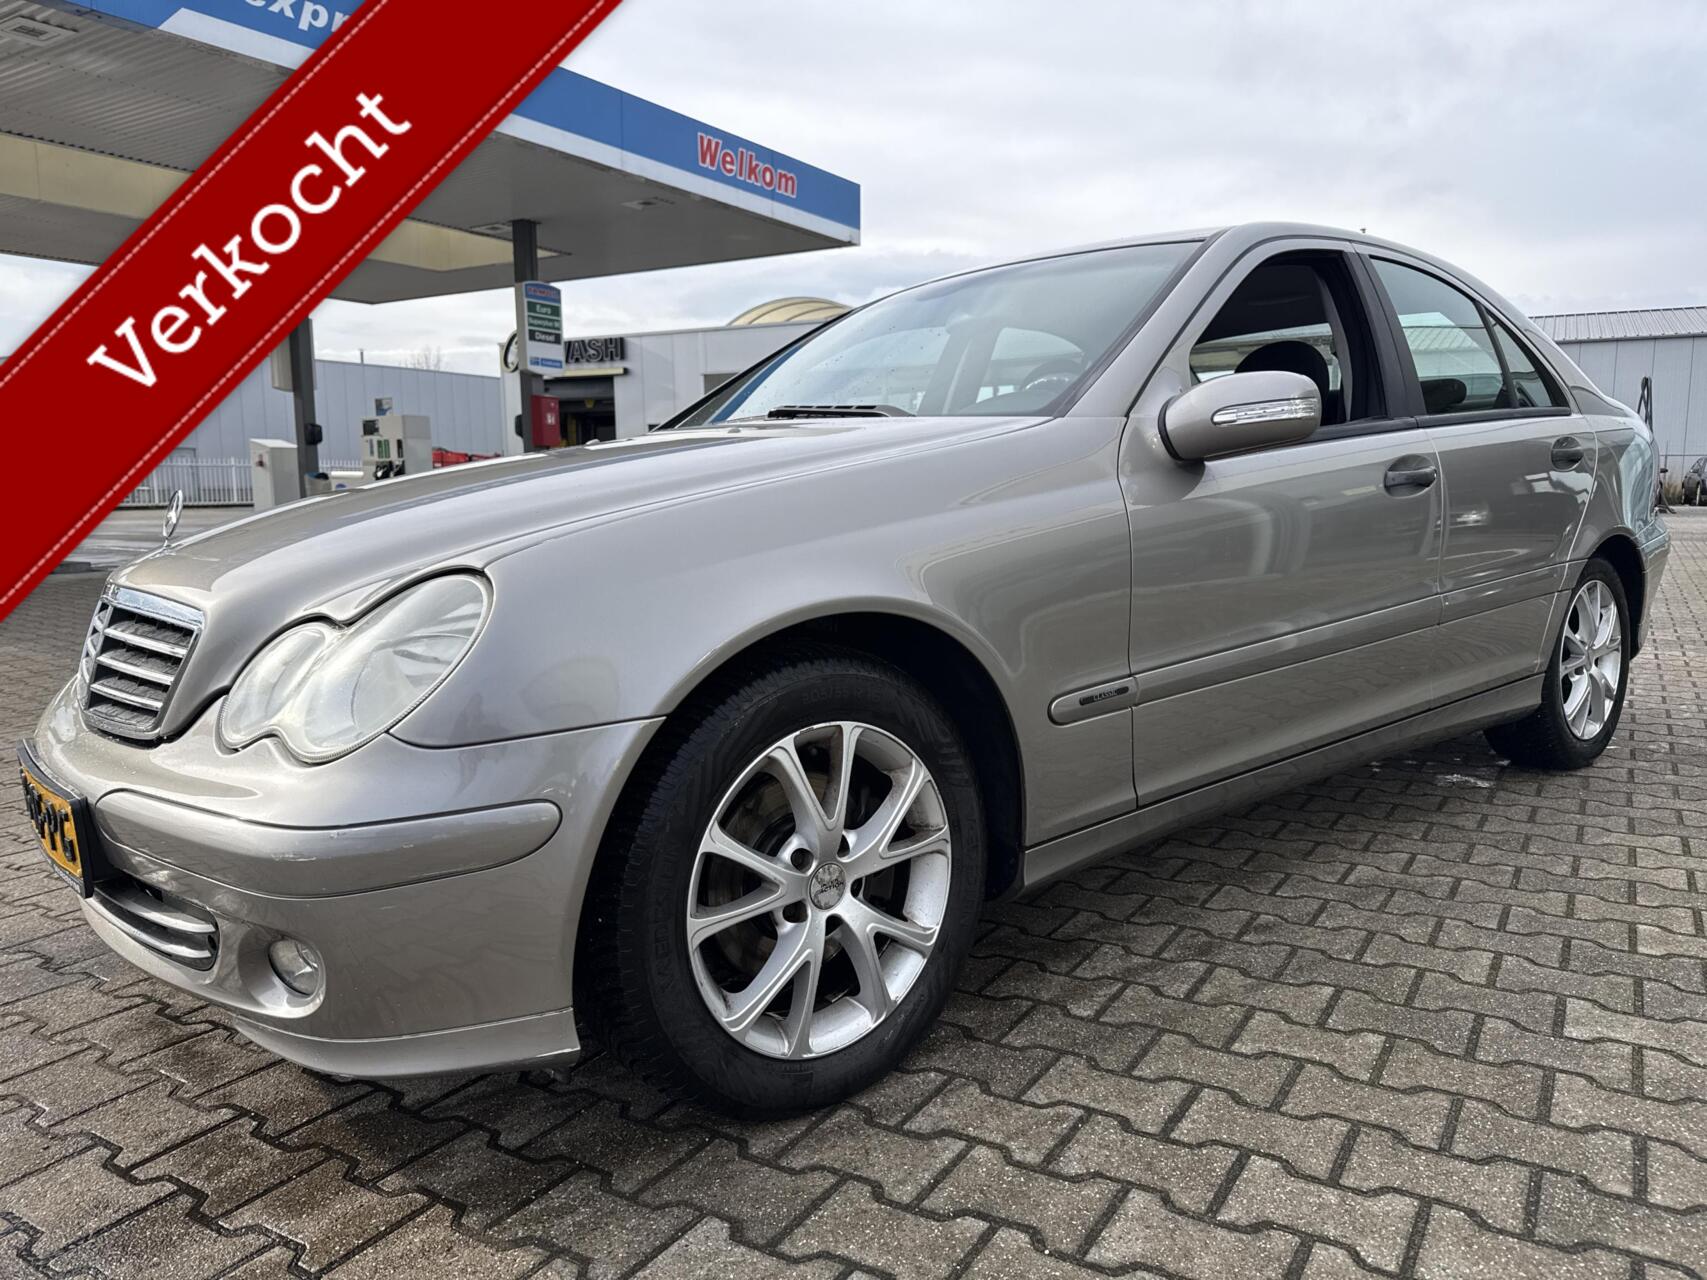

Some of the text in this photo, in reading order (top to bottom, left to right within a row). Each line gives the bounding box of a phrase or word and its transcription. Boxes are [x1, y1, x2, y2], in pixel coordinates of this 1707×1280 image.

[697, 132, 798, 199] Welkom
[534, 332, 556, 342] Diesel
[564, 337, 625, 364] ASH
